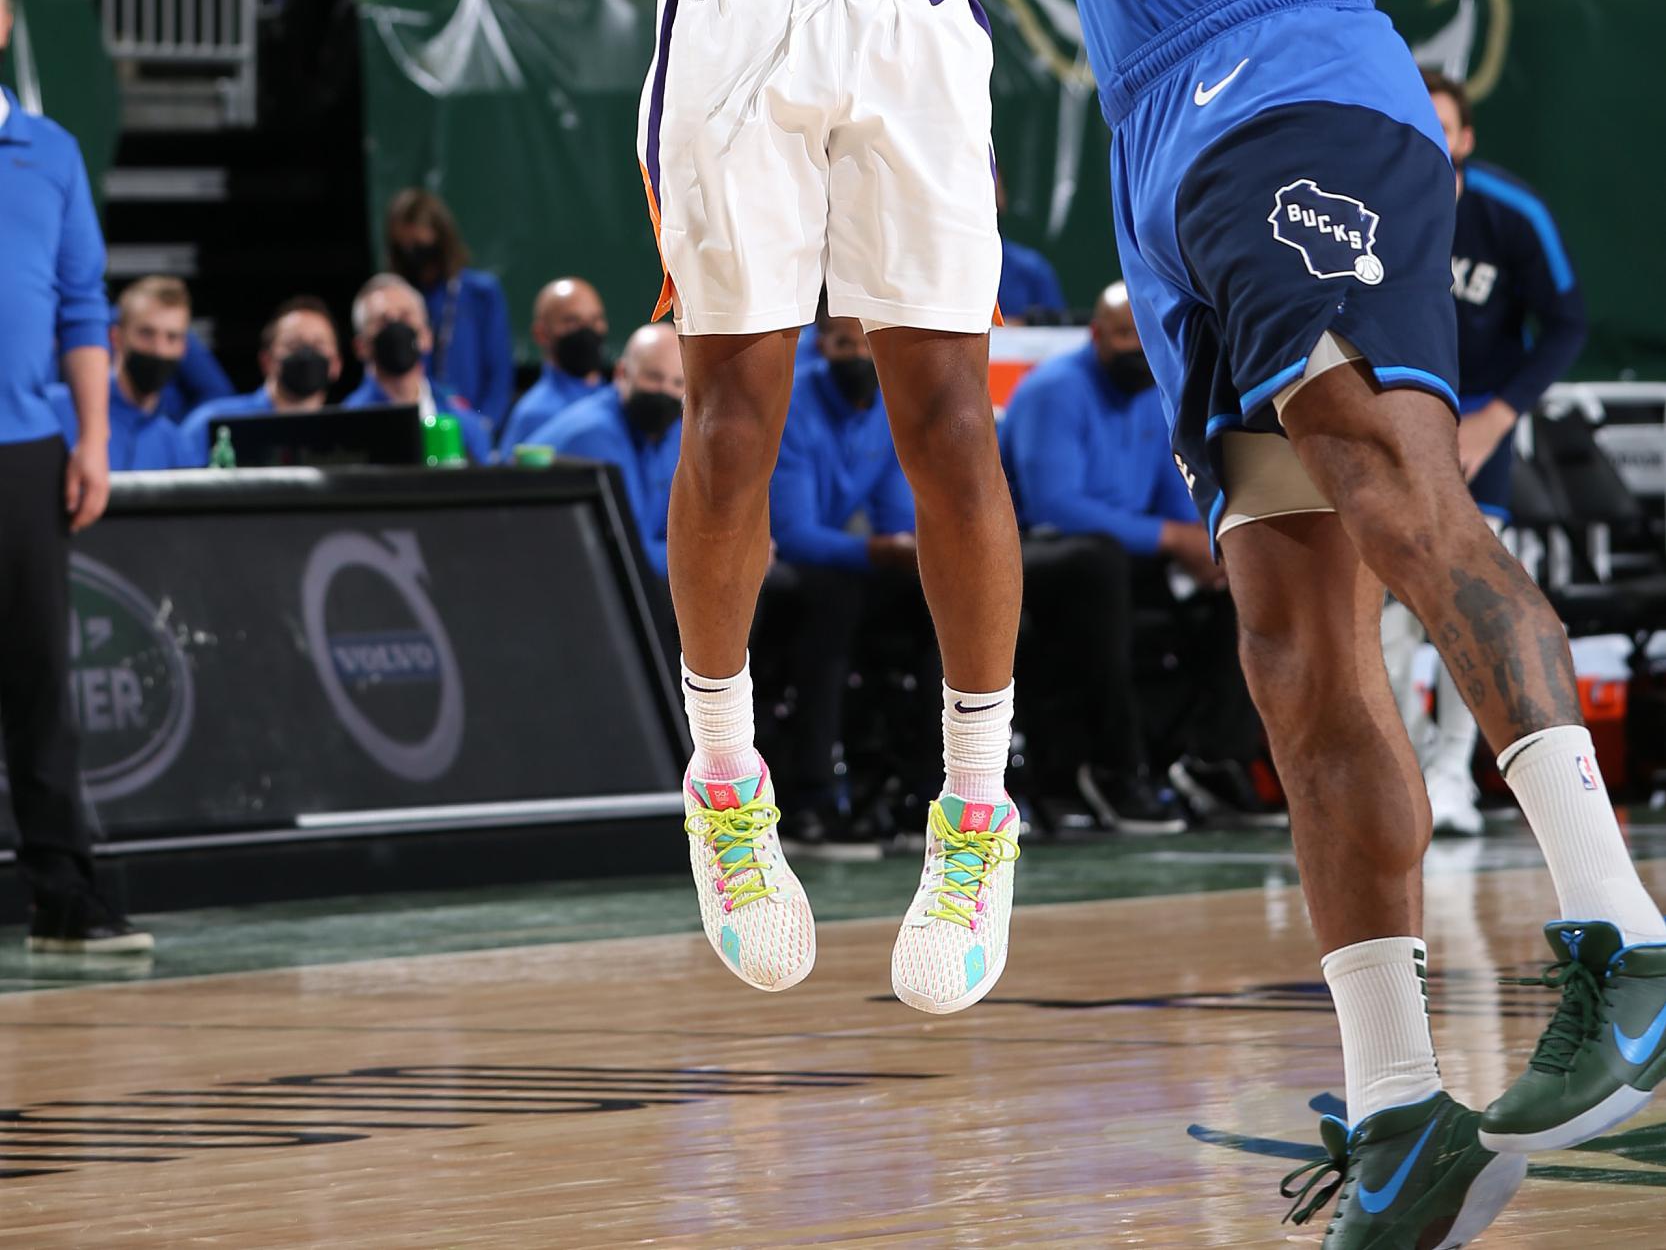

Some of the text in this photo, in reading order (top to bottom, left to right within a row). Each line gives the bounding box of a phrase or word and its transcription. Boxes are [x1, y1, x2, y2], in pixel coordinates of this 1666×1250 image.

[1286, 203, 1363, 250] BUCKS
[1450, 255, 1498, 306] KS
[334, 643, 435, 673] VOLVO
